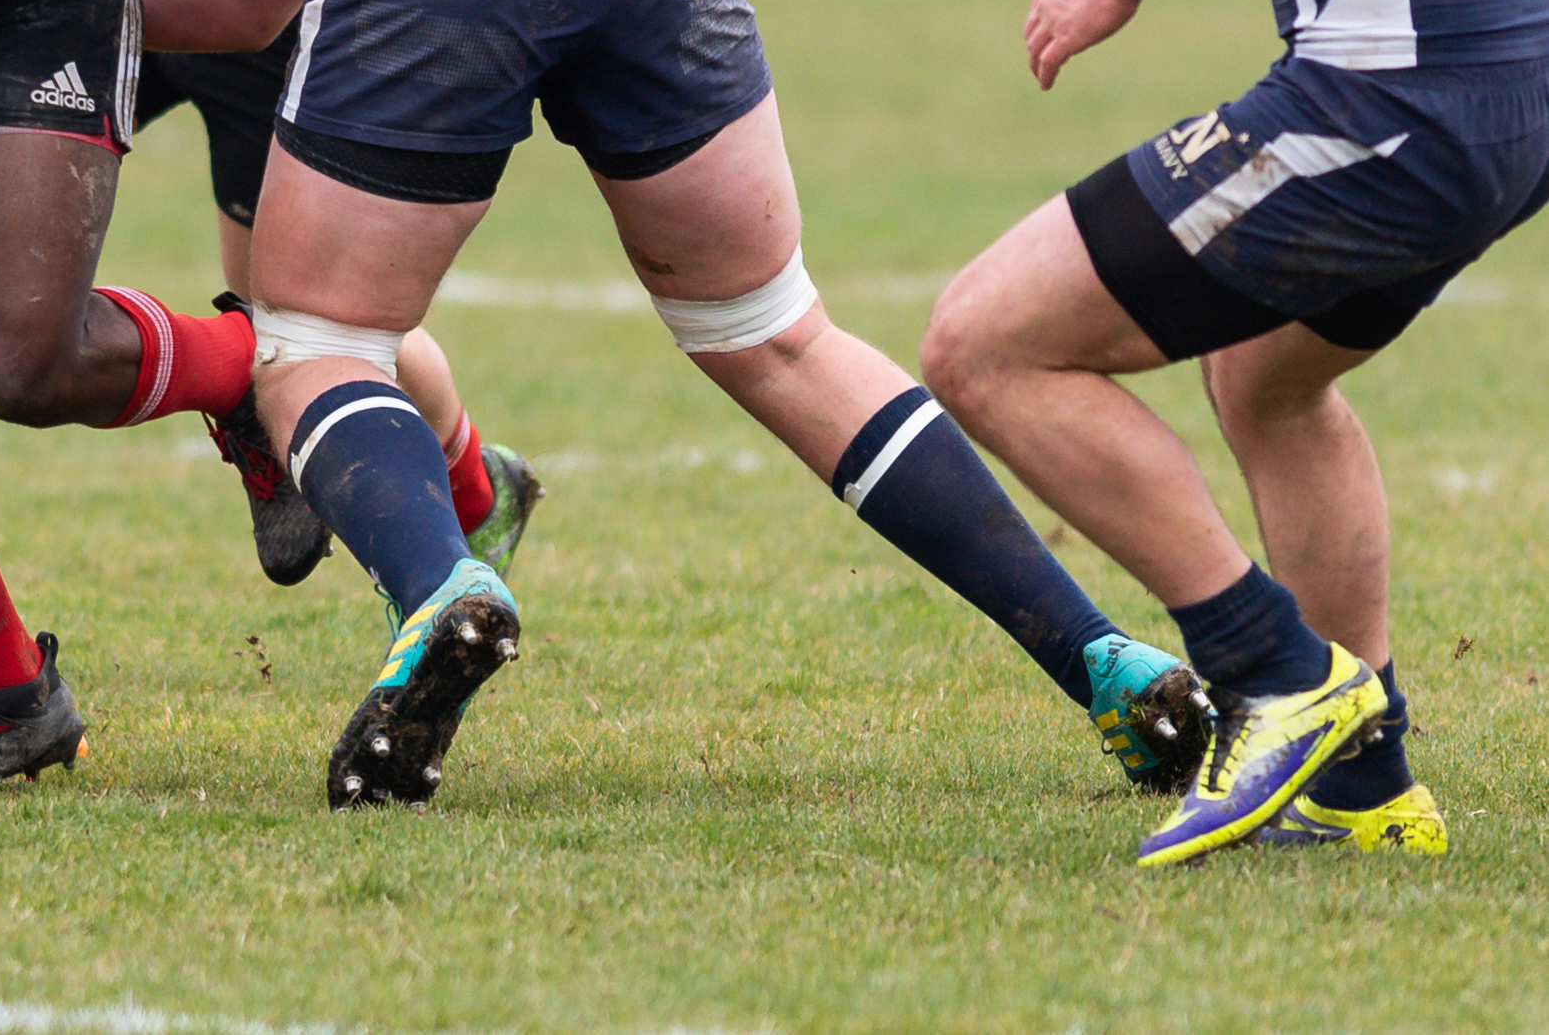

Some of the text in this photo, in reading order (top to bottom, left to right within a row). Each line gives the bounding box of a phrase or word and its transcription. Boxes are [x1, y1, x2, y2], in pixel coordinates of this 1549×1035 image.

[30, 88, 96, 113] adidas
[1155, 134, 1189, 181] NAVY
[1170, 109, 1232, 165] N
